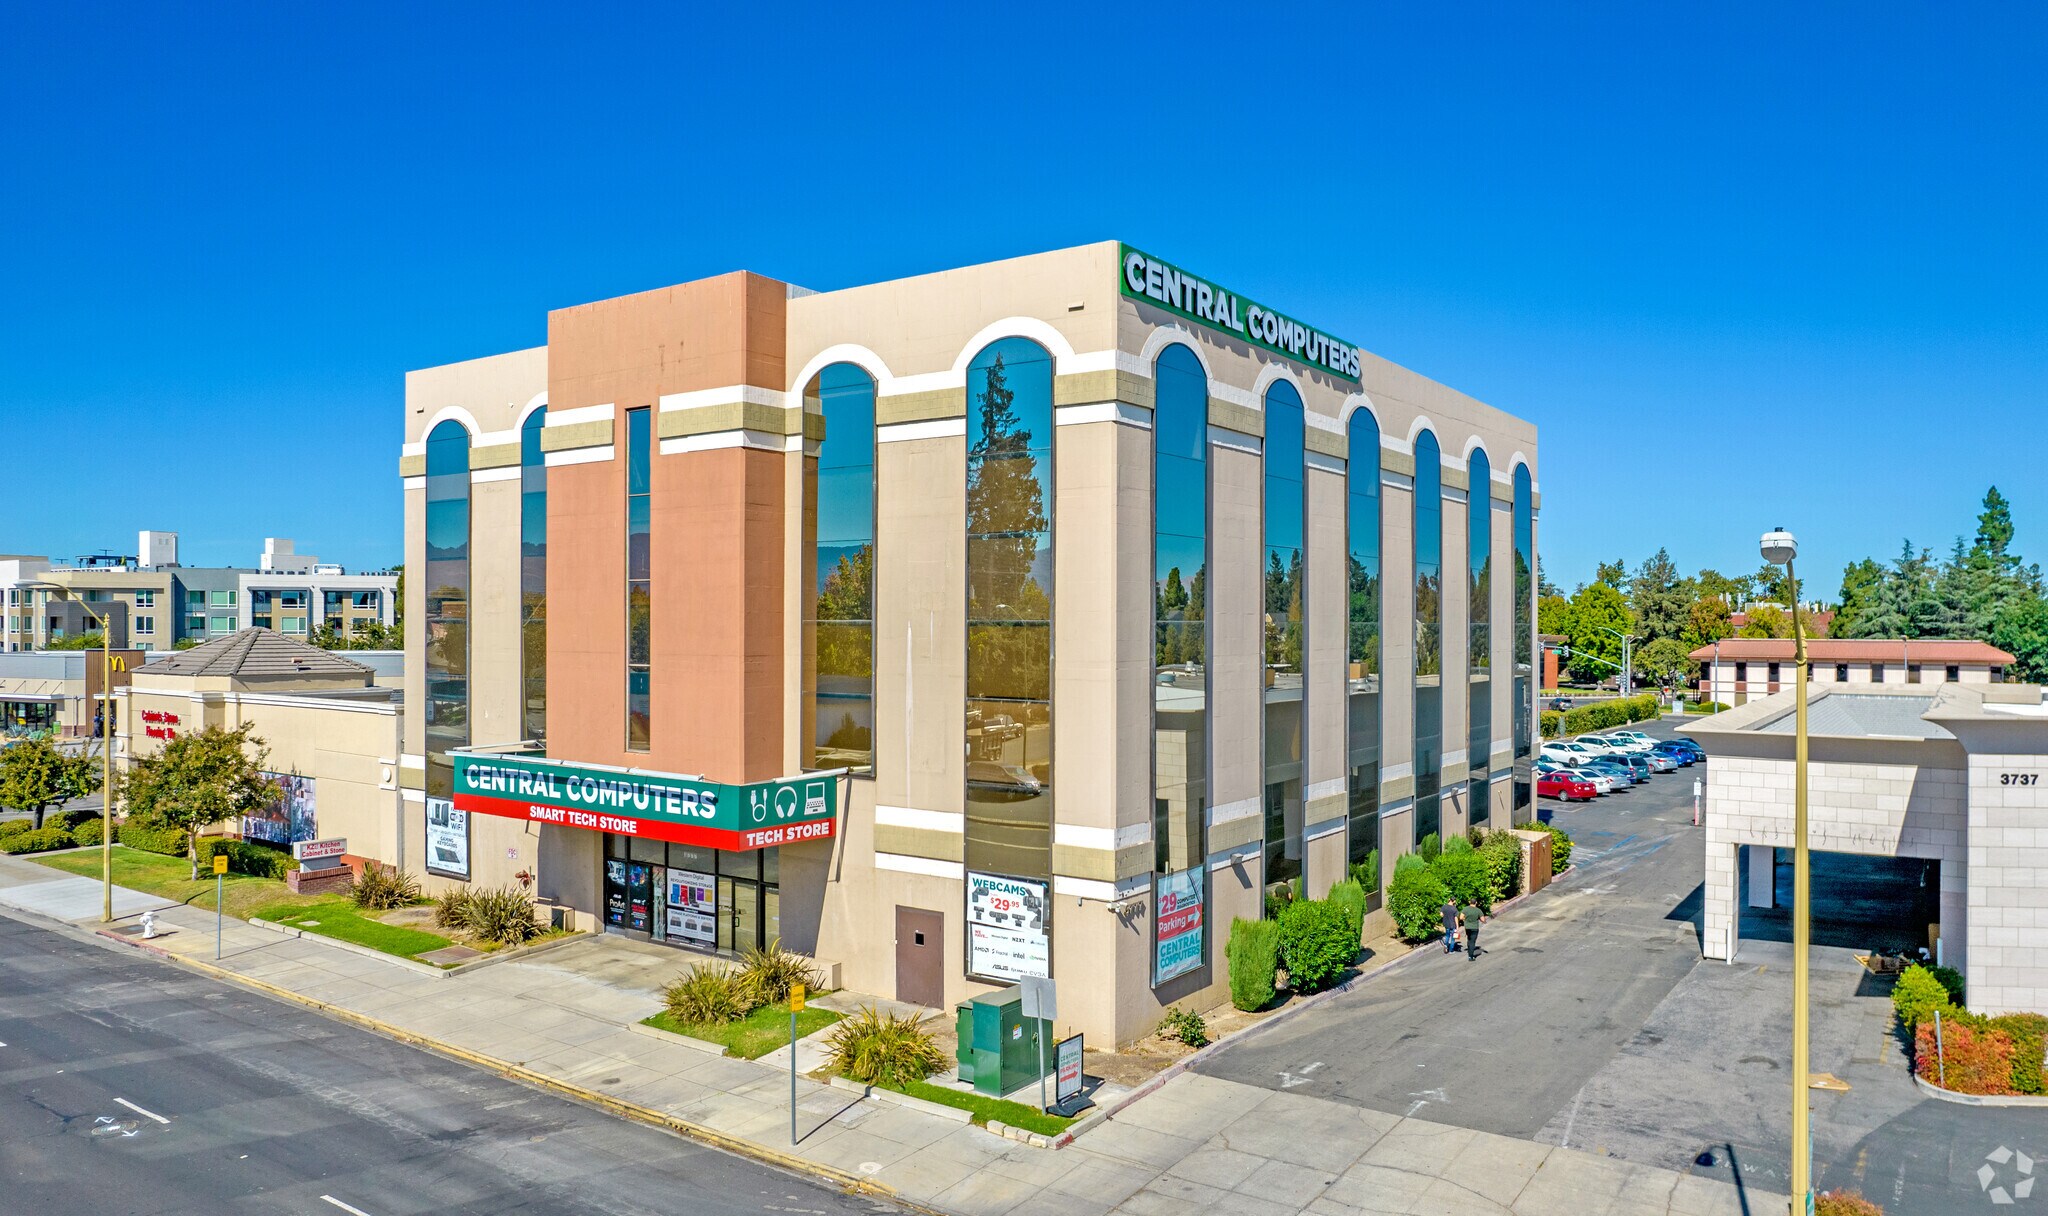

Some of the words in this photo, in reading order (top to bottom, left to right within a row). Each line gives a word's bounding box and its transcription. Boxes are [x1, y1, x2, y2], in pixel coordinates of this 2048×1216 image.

[1124, 252, 1244, 333] CENTRAL
[1246, 304, 1361, 379] COMPUTERS
[2000, 773, 2039, 785] 3737
[466, 763, 562, 799] CENTRAL
[566, 775, 717, 819] COMPUTERS
[529, 805, 566, 823] SMART
[568, 811, 597, 828] TECH
[600, 816, 638, 834] STORE
[746, 829, 784, 847] TECH
[786, 822, 830, 841] STORE
[301, 849, 323, 857] Cabinet
[319, 841, 341, 849] Kitchen
[972, 877, 1026, 897] WEBCAMS
[990, 896, 1020, 911] $29.95
[1158, 892, 1177, 915] $29
[1158, 915, 1187, 934] Parking
[1012, 936, 1025, 944] NZXT
[1160, 932, 1200, 958] CENTRAL
[1012, 951, 1026, 960] intel
[1160, 945, 1200, 969] COMPUTERS
[991, 963, 1009, 971] ASUS
[1060, 1061, 1079, 1074] PARKING
